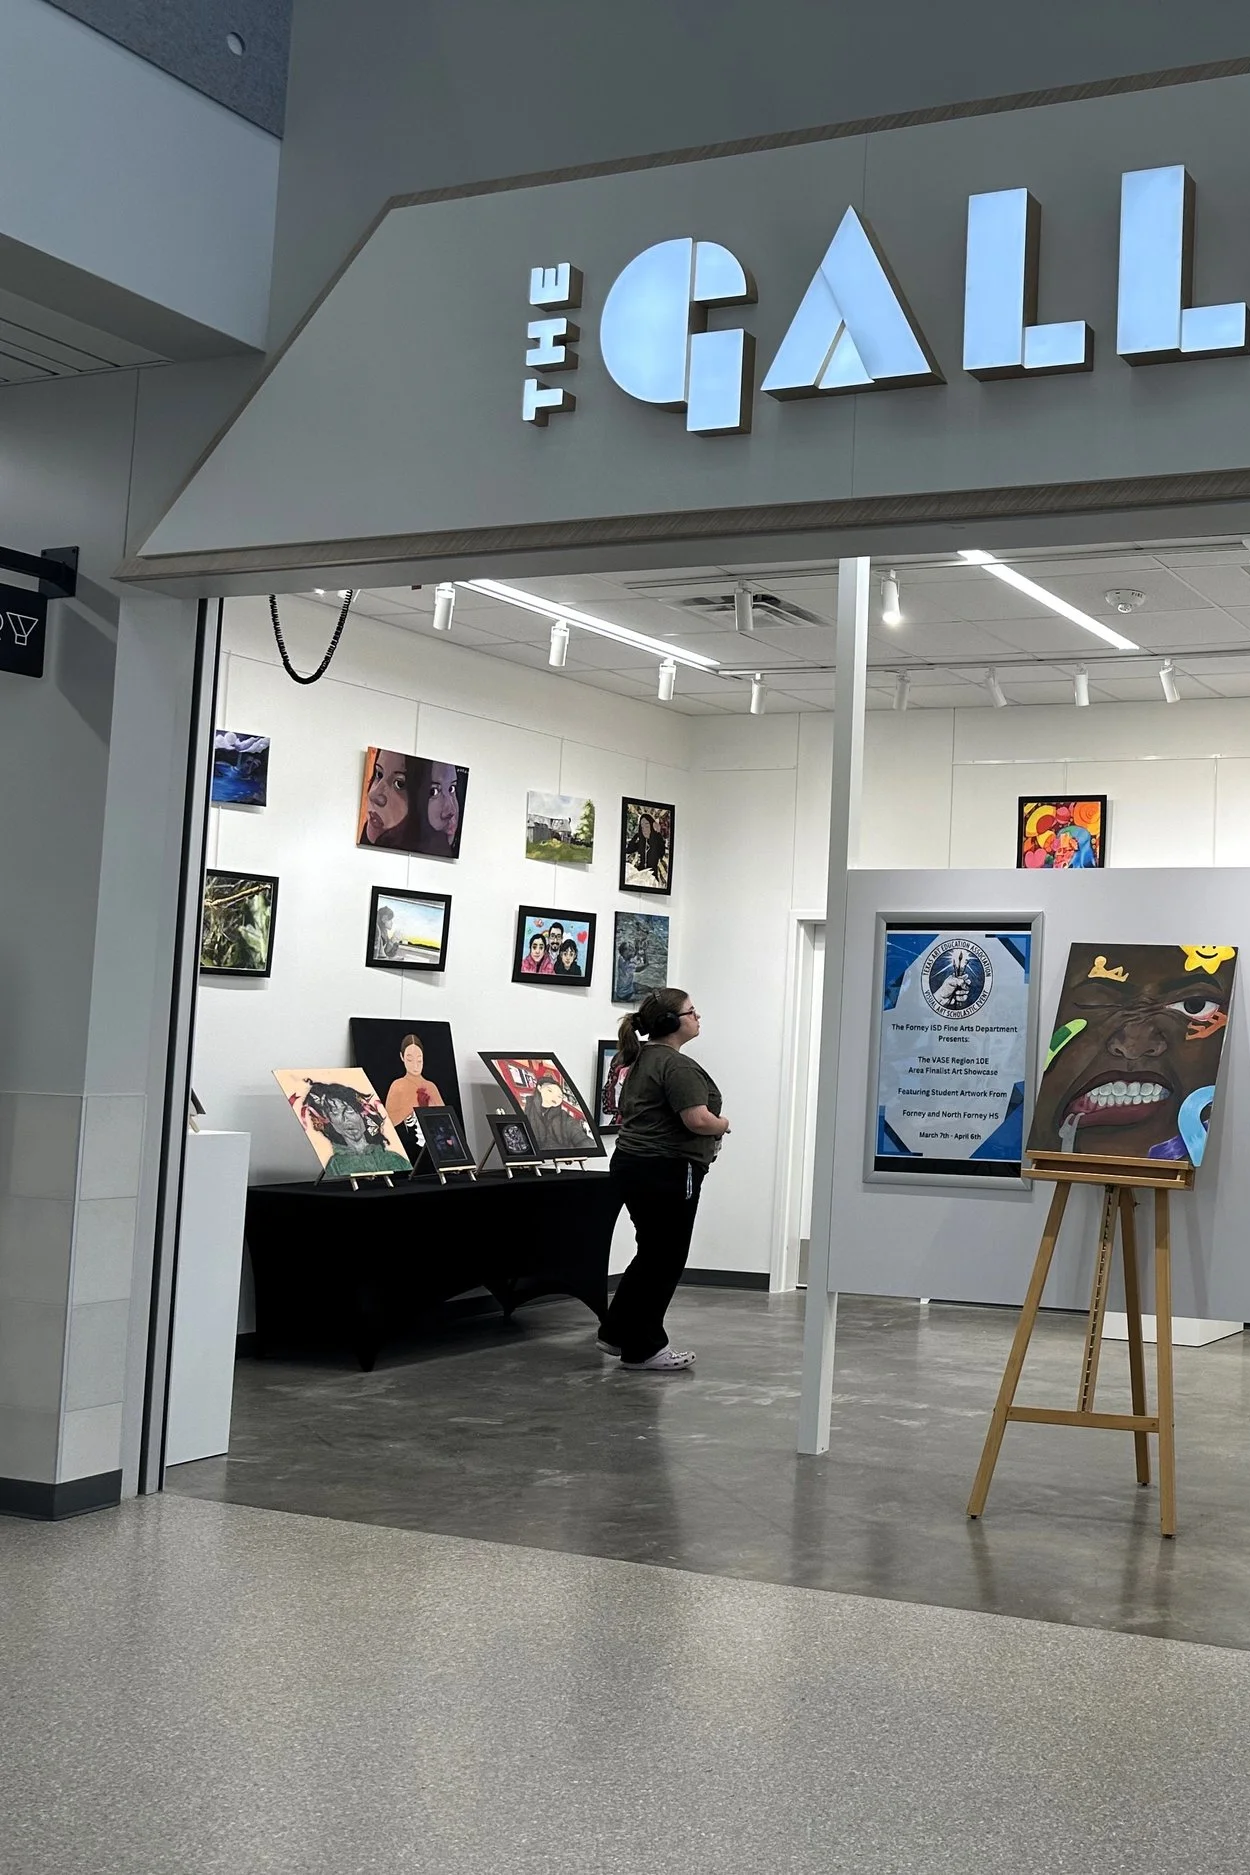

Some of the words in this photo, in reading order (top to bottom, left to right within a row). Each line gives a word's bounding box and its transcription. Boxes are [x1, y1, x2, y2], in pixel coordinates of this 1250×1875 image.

[522, 261, 580, 426] THE
[0, 612, 38, 646] Y
[923, 959, 933, 975] TEXAS
[933, 948, 942, 959] ART
[941, 941, 970, 951] EDUCATION
[971, 946, 991, 977] ASSOCIATION
[924, 990, 936, 1008] VISUAL
[936, 1007, 946, 1015] ART
[947, 1005, 977, 1017] SCHOLASTIC
[976, 990, 988, 1008] EVENT
[898, 1088, 930, 1096] Featuring
[903, 1110, 926, 1118] Forney
